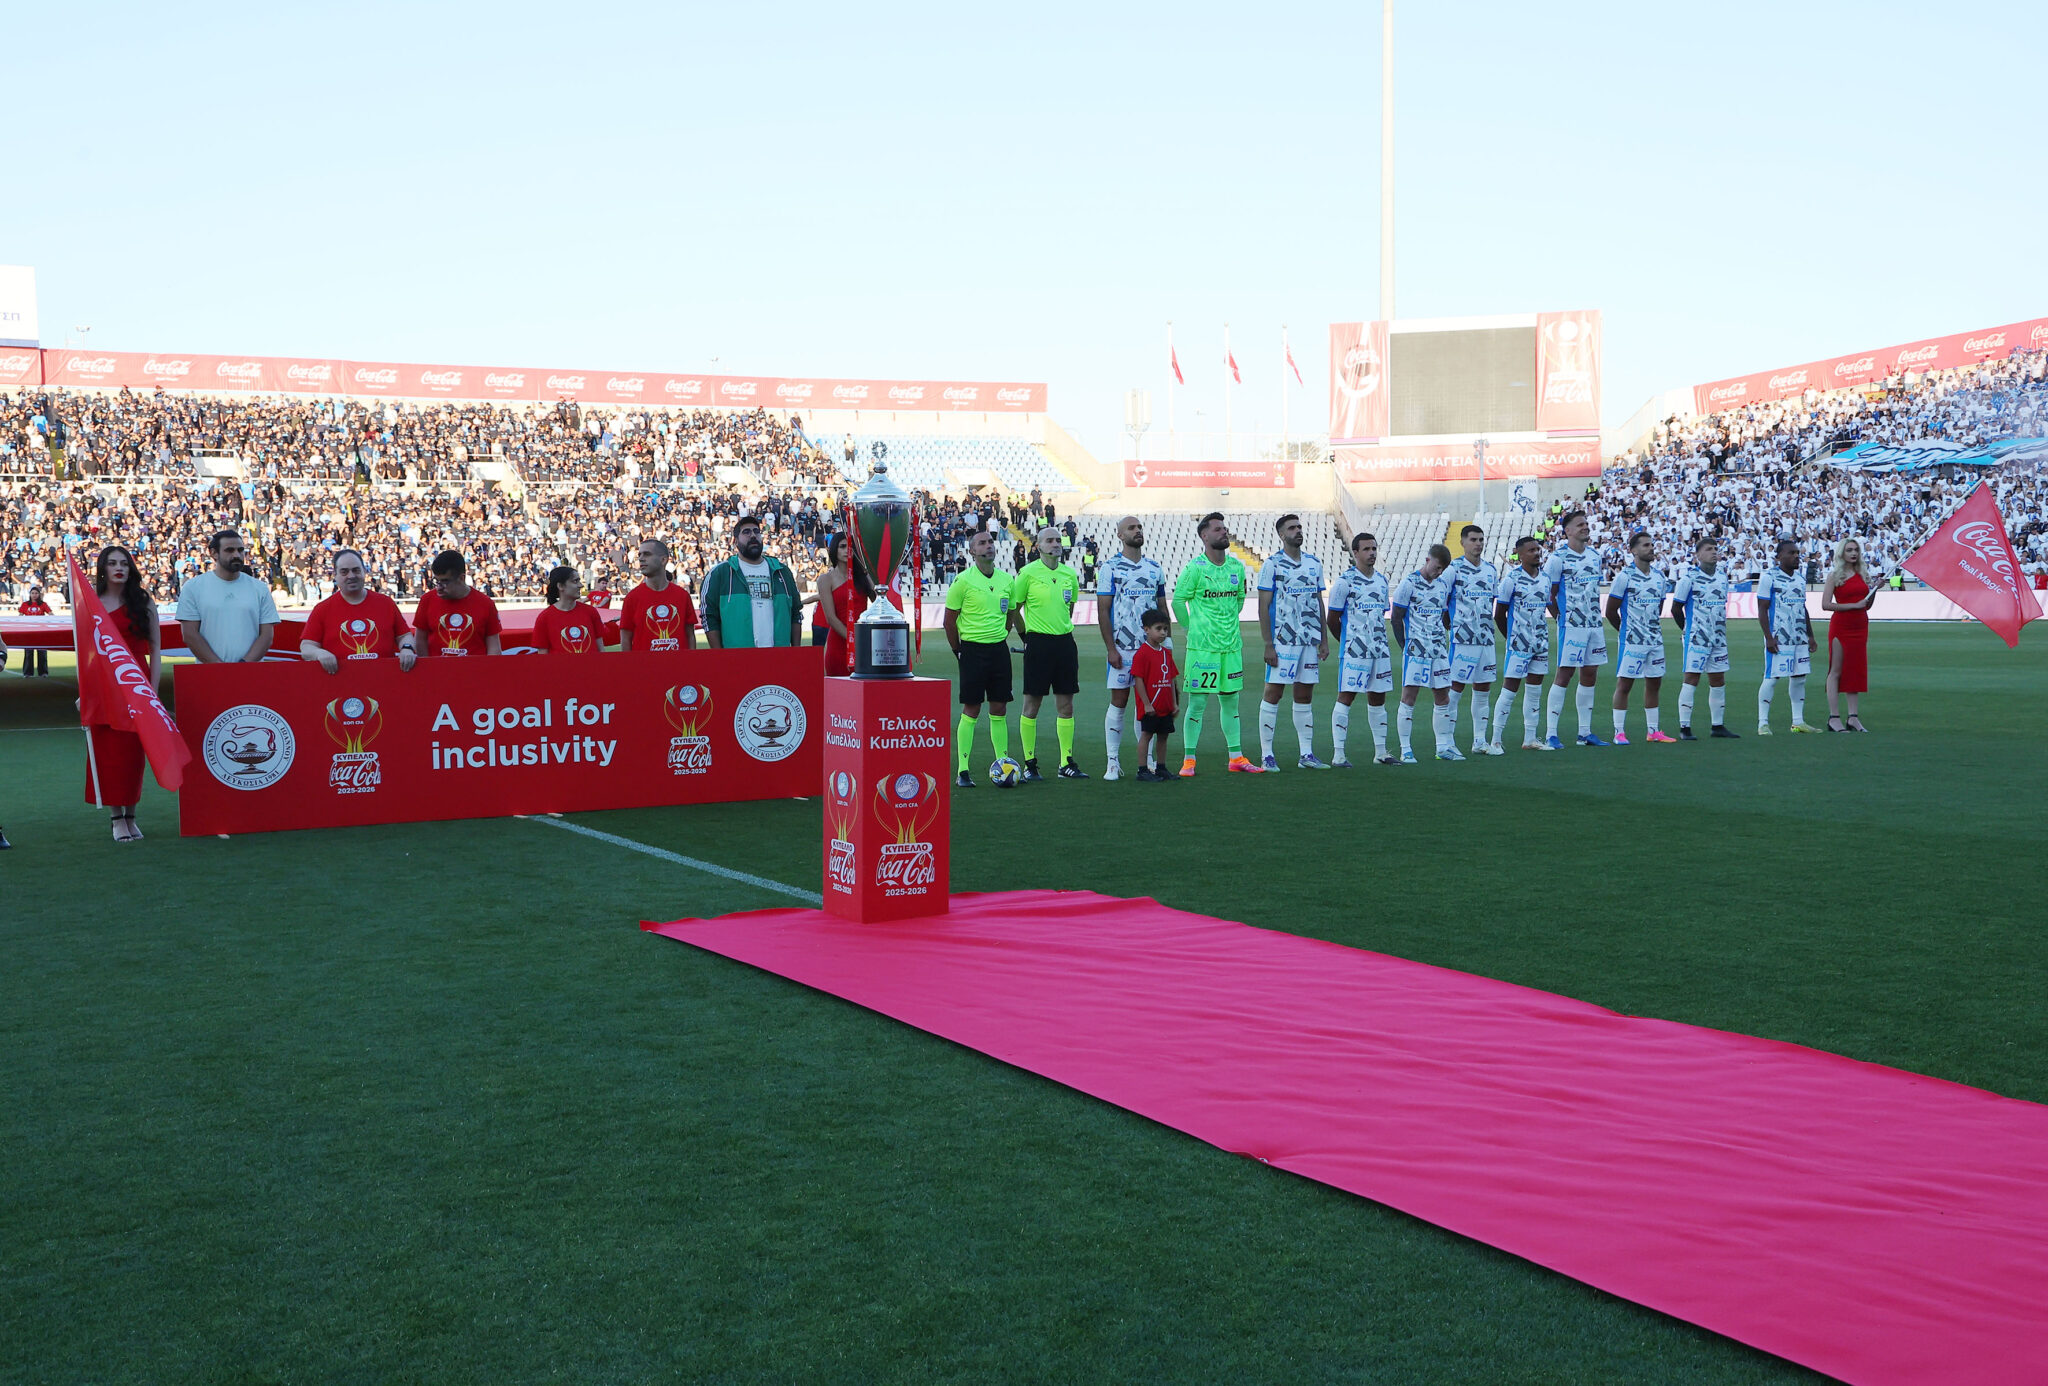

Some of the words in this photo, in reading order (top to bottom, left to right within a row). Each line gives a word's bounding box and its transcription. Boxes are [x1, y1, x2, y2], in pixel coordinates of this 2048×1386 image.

[1963, 332, 2008, 352] Coca-Cola
[1898, 344, 1939, 364] Coca-Cola
[67, 357, 117, 373] Coca-Cola
[143, 360, 192, 375] Coca-Cola
[216, 361, 262, 377] Coca-Cola
[287, 364, 331, 379] Coca-Cola
[1834, 357, 1875, 376] Coca-Cola
[355, 368, 398, 383] Coca-Cola
[421, 370, 463, 386] Coca-Cola
[485, 372, 525, 387] Coca-Cola
[547, 374, 586, 390] Coca-Cola
[1769, 370, 1808, 389] Coca-Cola
[606, 377, 646, 391] Coca-Cola
[665, 379, 704, 394] Coca-Cola
[721, 381, 757, 396] Coca-Cola
[776, 383, 814, 397] Coca-Cola
[833, 384, 869, 398] Coca-Cola
[1710, 382, 1747, 400] Coca-Cola
[888, 386, 925, 399] Coca-Cola
[943, 386, 979, 400] Coca-Cola
[997, 387, 1032, 401] Coca-Cola
[1354, 457, 1418, 470] ΑΛΗΘΙΝΗ
[1422, 456, 1473, 468] ΜΑΓΕΙΑ
[1509, 452, 1591, 465] ΚΥΠΕΛΛΟΥ!
[1958, 559, 1978, 576] Real
[1976, 573, 2003, 594] Magic
[1203, 589, 1238, 598] Stoixima
[1286, 586, 1317, 594] Stoiximan
[1201, 672, 1217, 688] 22
[1421, 668, 1430, 683] 5
[1466, 665, 1475, 680] 7
[213, 709, 244, 732] ΧΡΙΣΤΟΥ
[432, 703, 460, 732] A
[472, 699, 552, 735] goal
[564, 697, 615, 726] for
[830, 713, 857, 733] Τελικός
[878, 716, 937, 732] Τελικός
[826, 731, 861, 749] Κυπέλλου
[870, 735, 945, 749] Κυπέλλου
[336, 753, 374, 761] ΚΥΠΕΛΛΟ
[432, 735, 617, 770] inclusivity
[222, 773, 263, 787] ΛΕΥΚΩΣΙΑ
[265, 770, 280, 782] 1981
[885, 844, 928, 853] ΚΥΠΕΛΛΟ
[885, 886, 927, 897] 2025-2026
